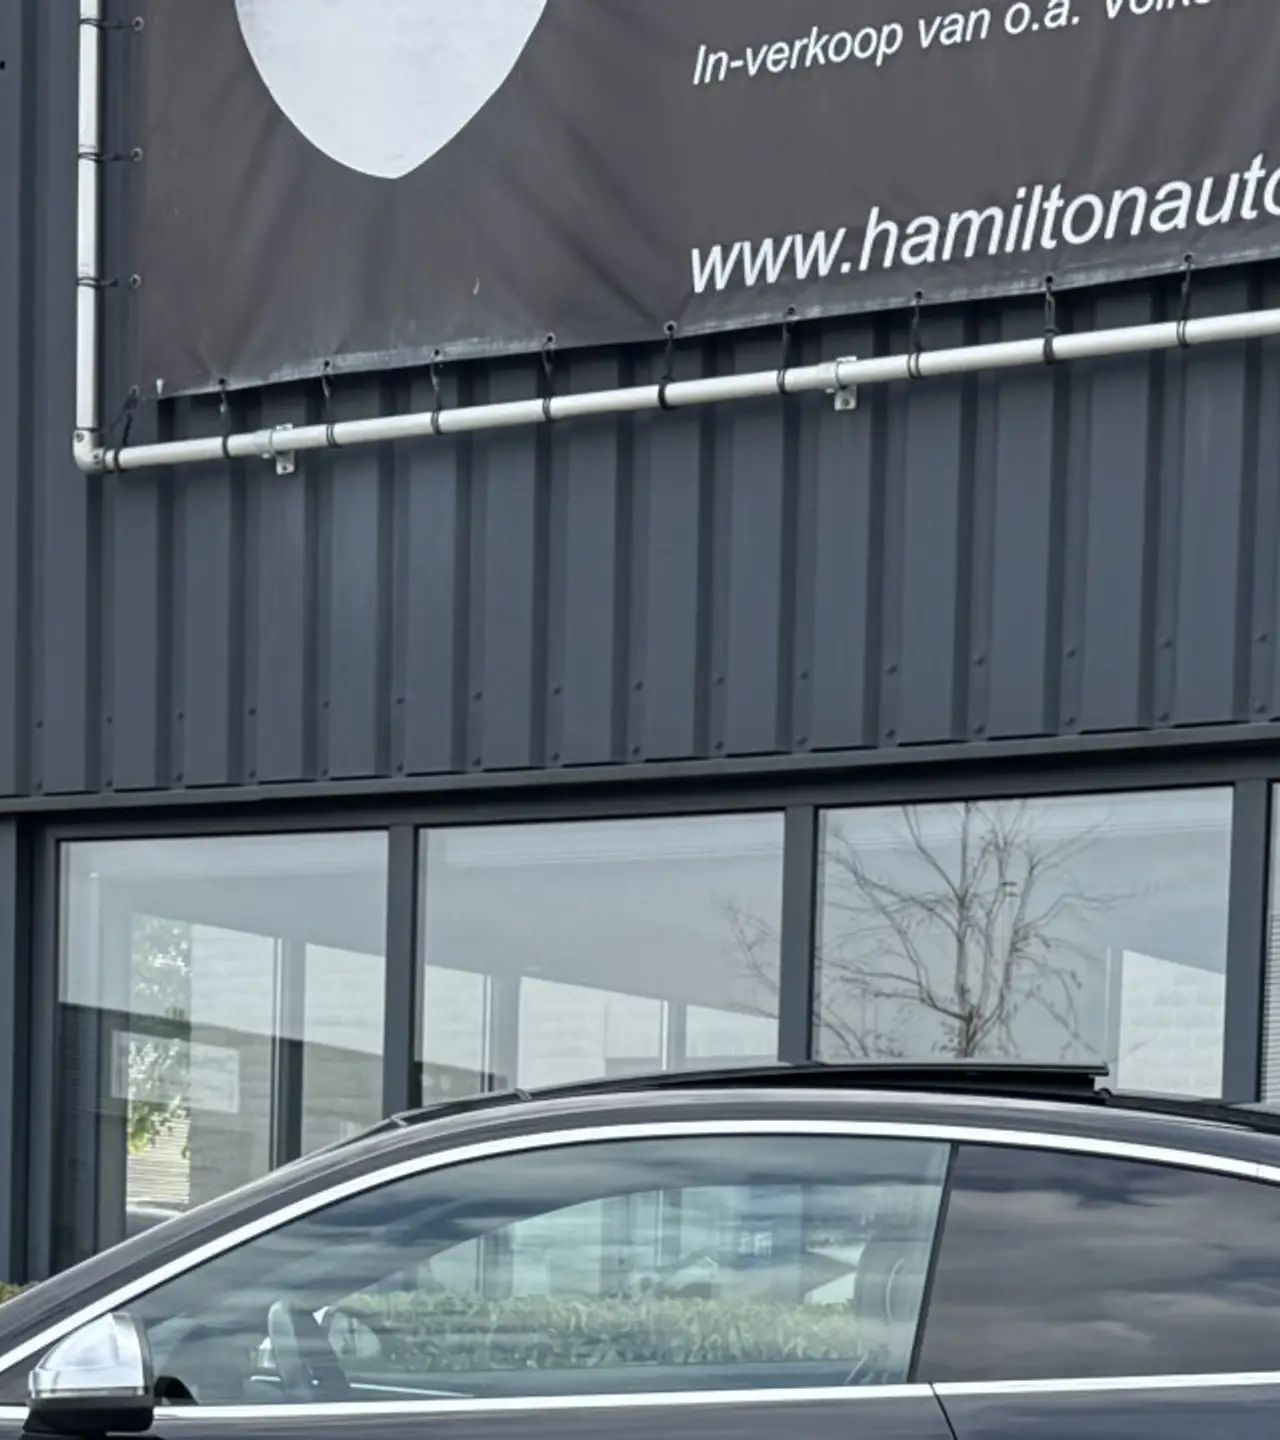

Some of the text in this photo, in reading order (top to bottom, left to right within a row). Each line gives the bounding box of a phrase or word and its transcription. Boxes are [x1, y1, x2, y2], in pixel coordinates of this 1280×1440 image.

[692, 22, 904, 86] In-verkoop
[918, 7, 991, 49] van
[1004, 0, 1080, 35] o.a.
